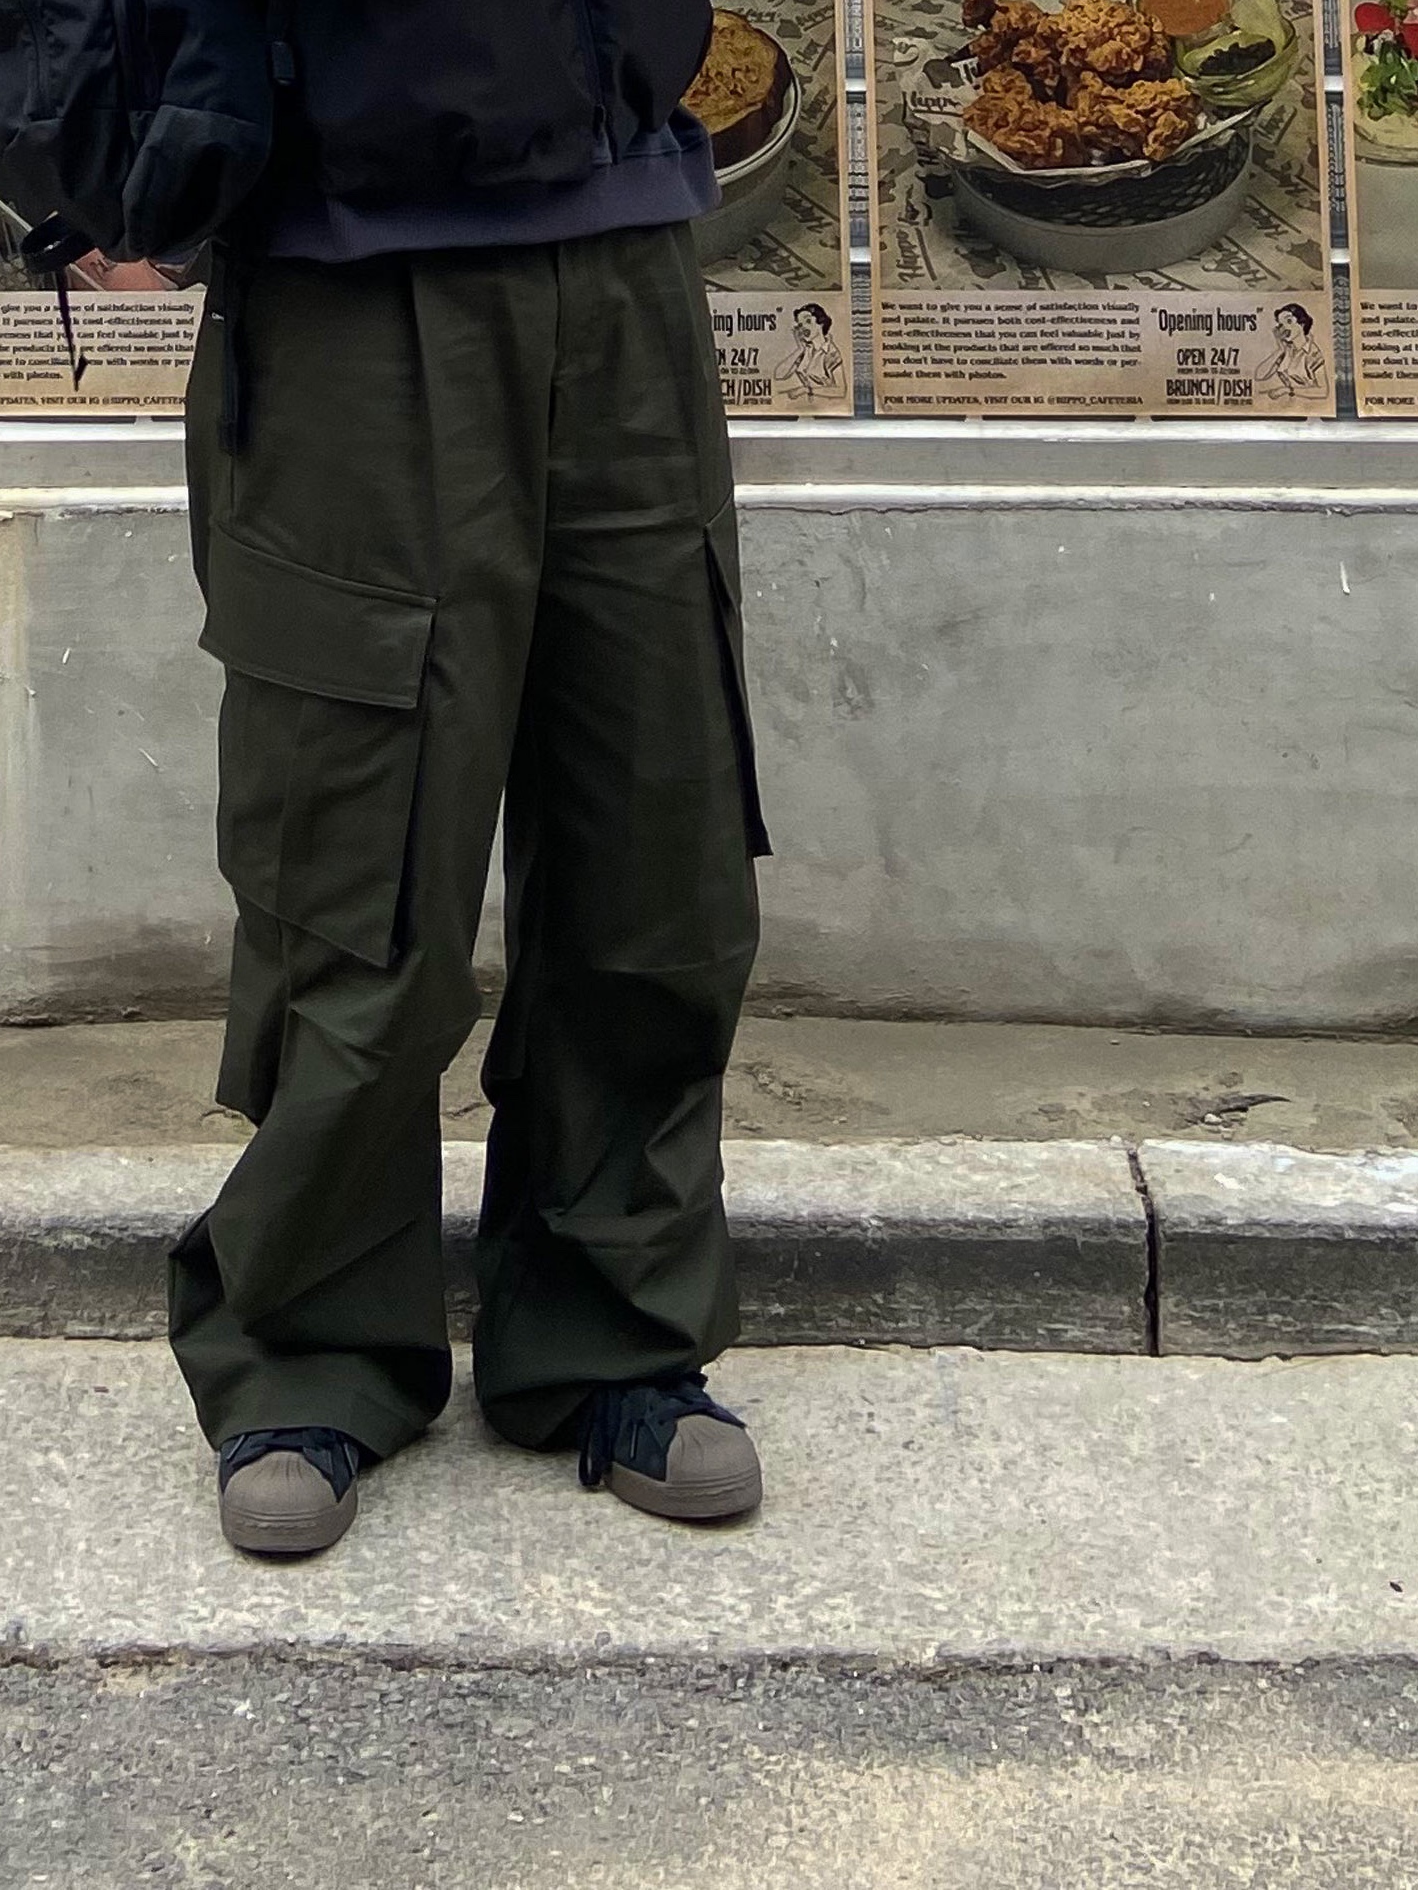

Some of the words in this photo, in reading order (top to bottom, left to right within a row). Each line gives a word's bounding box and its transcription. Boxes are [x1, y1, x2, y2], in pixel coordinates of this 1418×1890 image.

[731, 347, 760, 367] 24/7
[1176, 347, 1208, 369] OPEN
[1210, 347, 1240, 369] 24/7
[743, 378, 772, 397] DISH
[1166, 379, 1216, 397] BRUNCH
[1223, 379, 1253, 397] DISH
